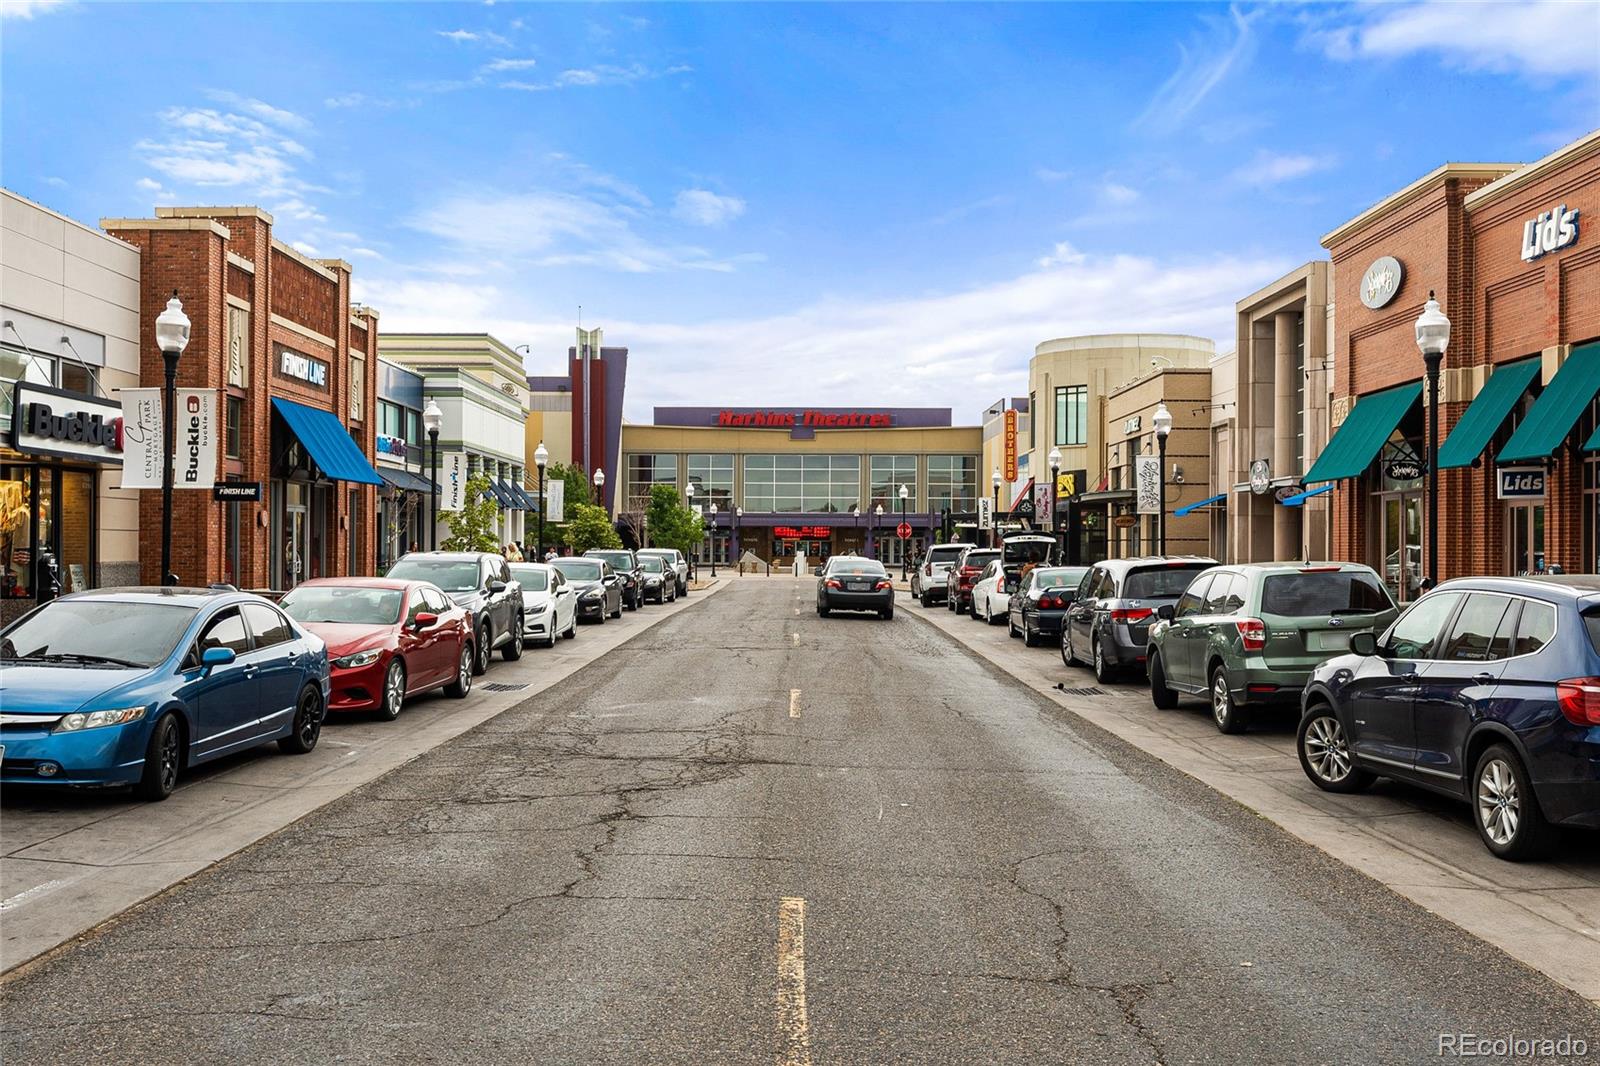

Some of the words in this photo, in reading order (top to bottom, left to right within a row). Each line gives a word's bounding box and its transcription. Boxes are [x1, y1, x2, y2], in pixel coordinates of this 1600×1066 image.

[1521, 204, 1580, 264] Lids
[281, 352, 309, 382] FINISH
[309, 360, 326, 386] LINE
[29, 403, 116, 449] Buckle
[144, 400, 152, 423] PARK
[719, 410, 795, 427] Harkins
[803, 410, 891, 427] Theatres
[145, 438, 153, 479] CENTRAL
[185, 416, 200, 482] Buckle
[219, 488, 241, 496] FINISH
[241, 488, 256, 496] LINE
[451, 480, 459, 508] Finish
[1503, 475, 1543, 491] Lids
